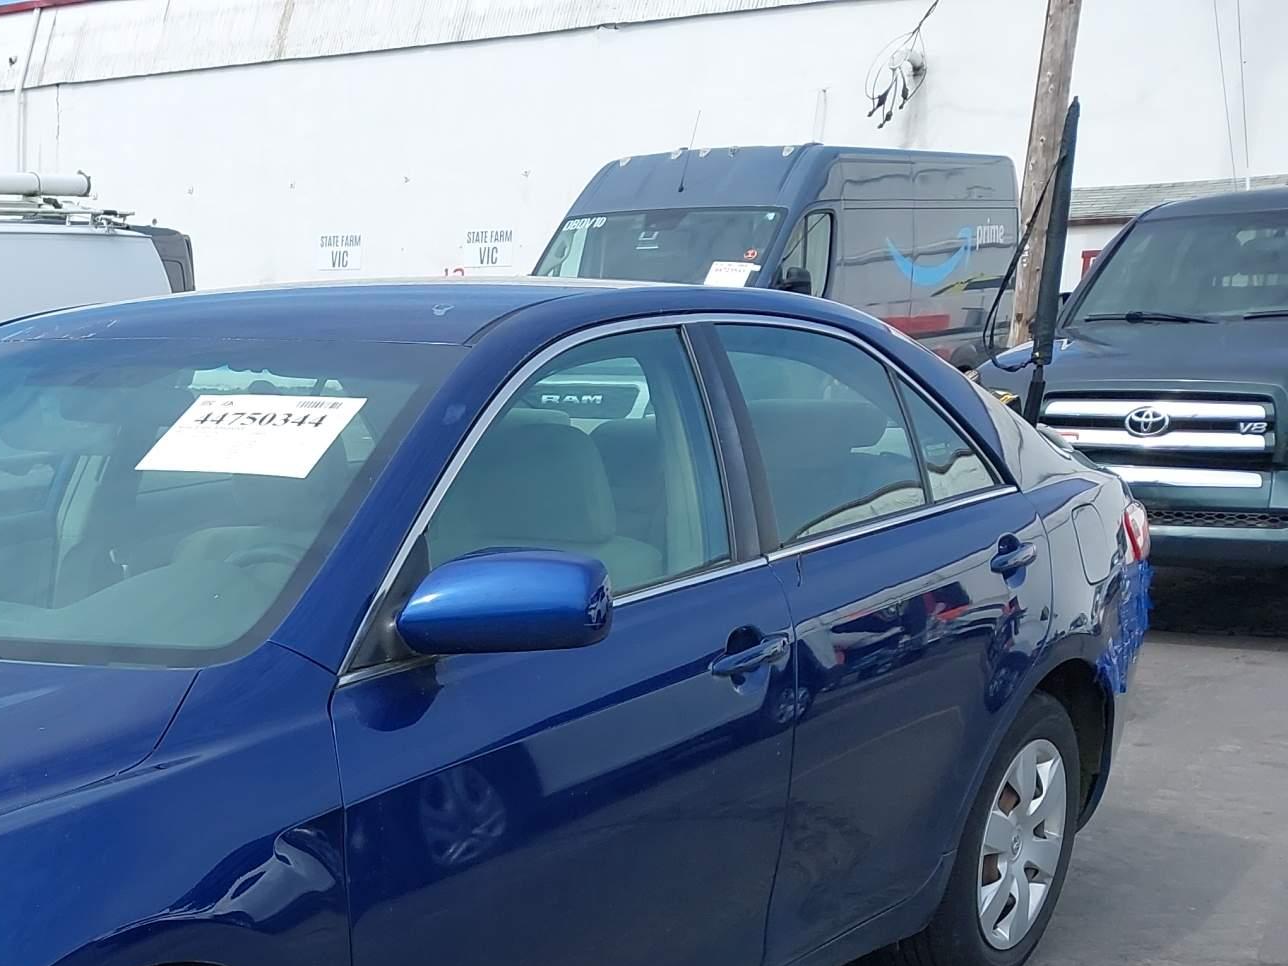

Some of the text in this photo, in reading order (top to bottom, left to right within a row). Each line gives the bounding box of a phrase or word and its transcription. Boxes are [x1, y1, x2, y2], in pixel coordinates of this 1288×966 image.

[320, 234, 361, 248] STATE FARM
[466, 230, 512, 244] STATE FARM
[976, 217, 1004, 250] prime
[331, 250, 349, 268] VIC
[479, 246, 498, 265] VIC
[541, 394, 603, 404] RAM
[194, 412, 328, 428] 44750344
[1239, 422, 1268, 433] V8
